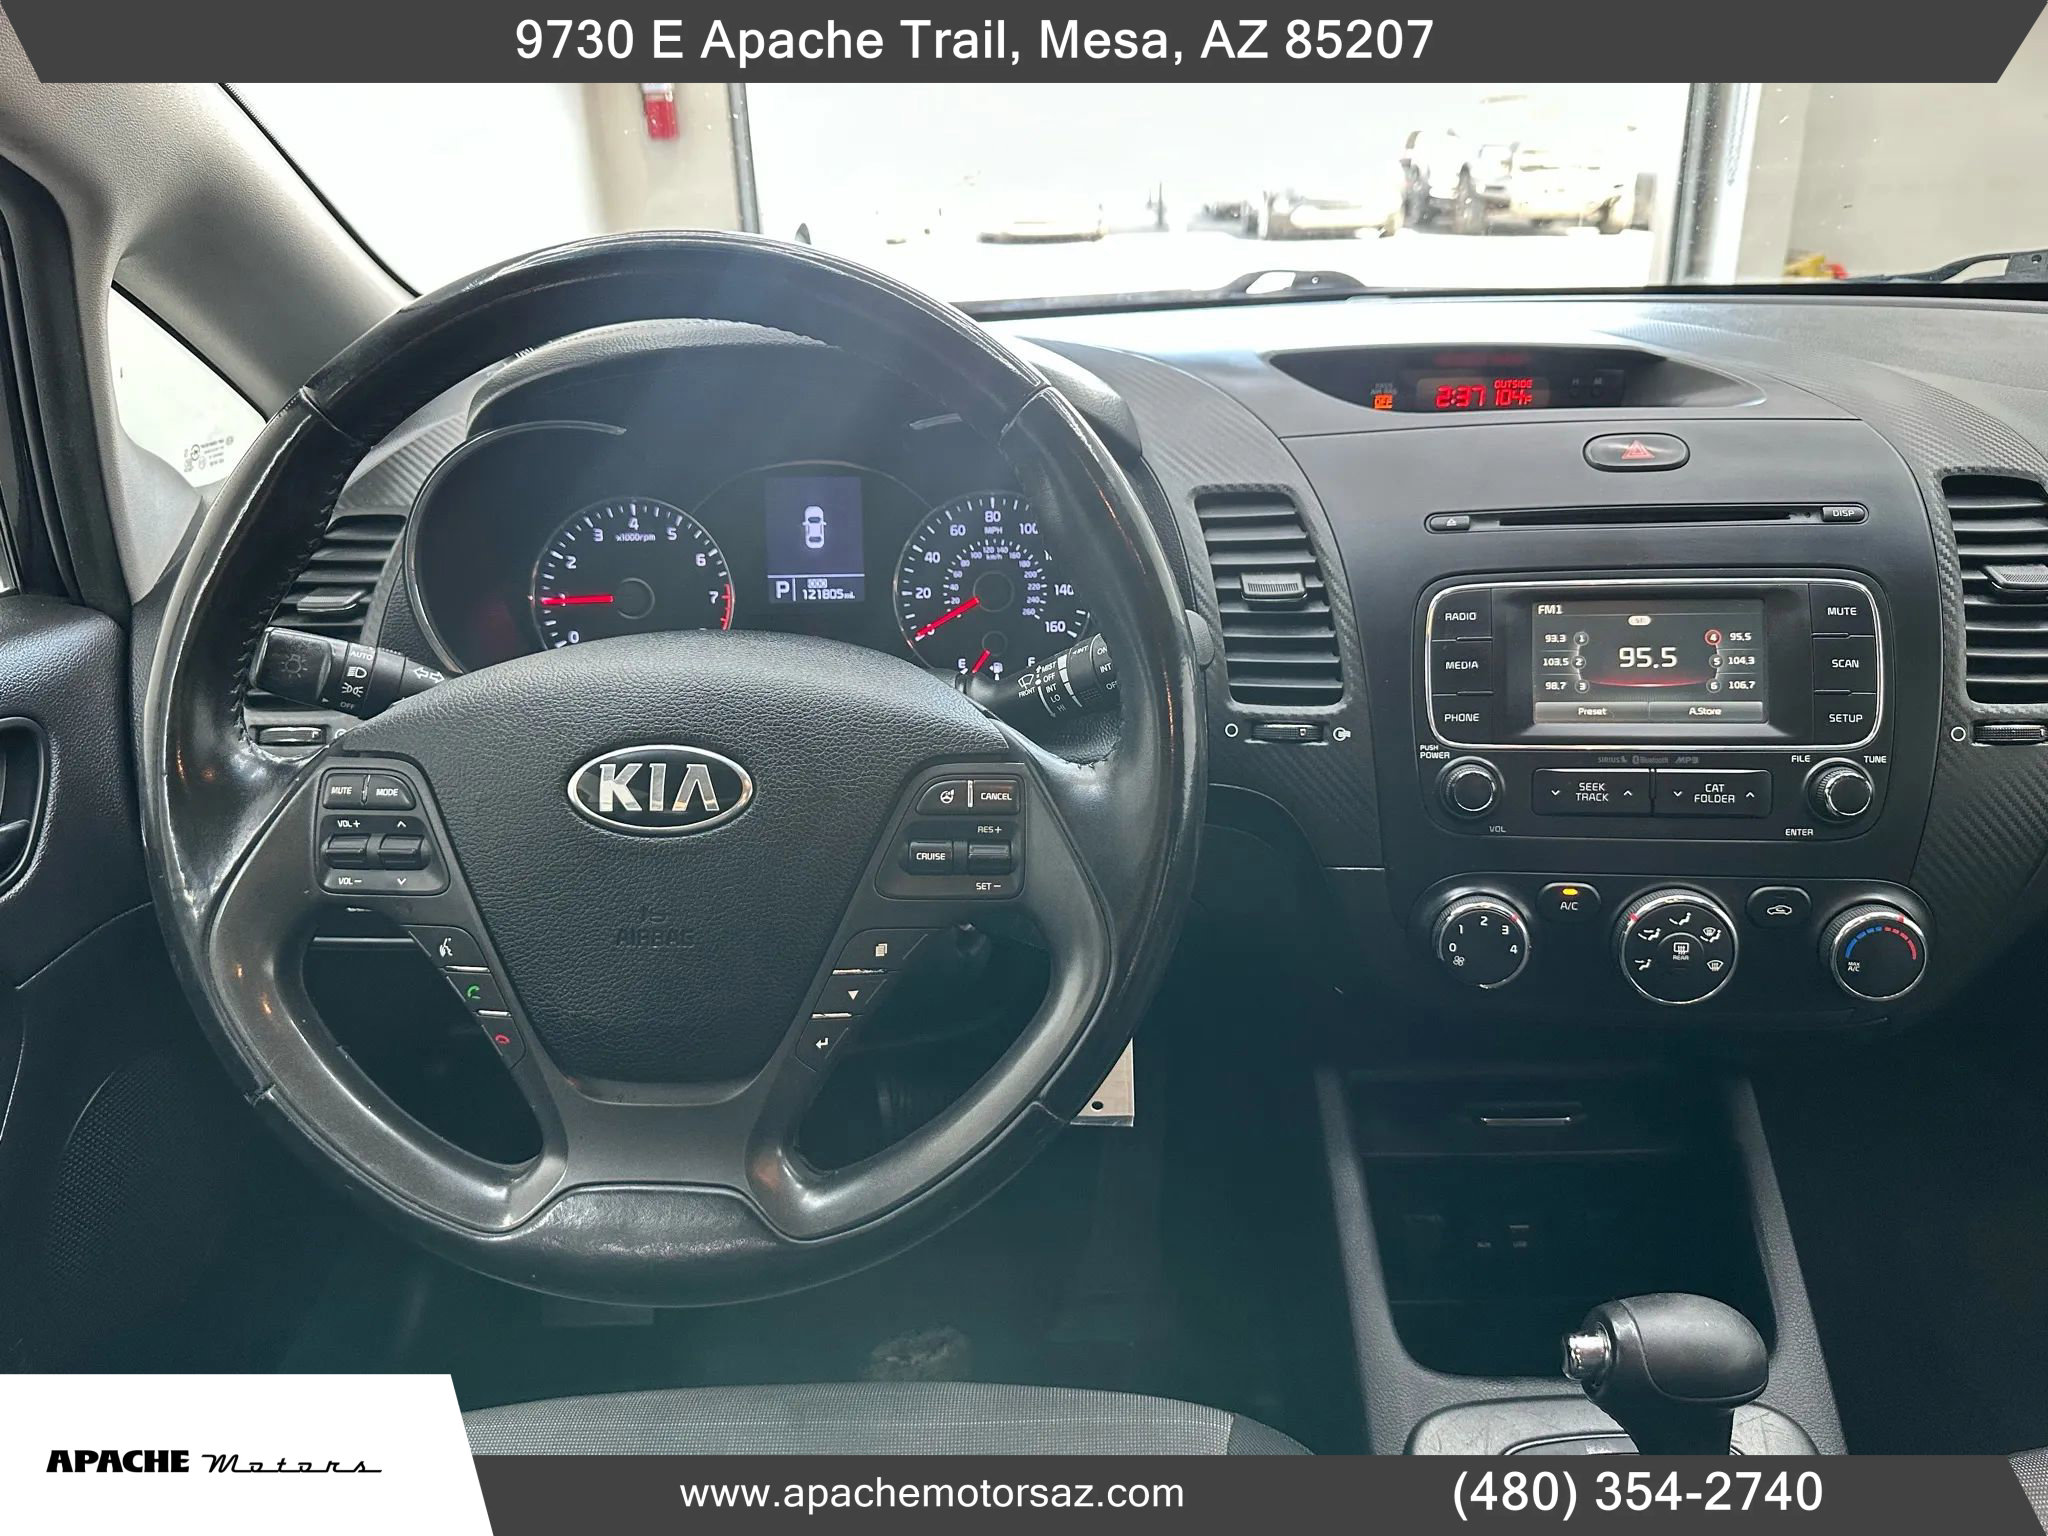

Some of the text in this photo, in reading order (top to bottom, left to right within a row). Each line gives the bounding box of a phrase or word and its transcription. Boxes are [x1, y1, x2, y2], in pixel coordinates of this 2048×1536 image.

[1494, 377, 1533, 389] OUTSIDE
[1435, 385, 1486, 408] 2:37
[984, 510, 1001, 523] 80
[1832, 509, 1855, 517] DISP
[628, 517, 640, 530] 4
[594, 528, 604, 542] 3
[667, 527, 678, 541] 5
[949, 524, 966, 537] 60
[984, 525, 1003, 535] MPH
[566, 555, 577, 570] 2
[695, 553, 706, 567] 6
[924, 552, 941, 564] 40
[1024, 571, 1037, 579] 200
[775, 580, 790, 599] P
[1027, 583, 1041, 591] 220
[709, 591, 719, 604] 7
[915, 587, 931, 599] 20
[1537, 604, 1563, 615] FM1
[1827, 607, 1858, 616] MUTE
[1445, 611, 1477, 621] RADIO
[1045, 621, 1066, 633] 160
[568, 630, 580, 644] 0
[1545, 634, 1566, 643] 93.3
[1709, 632, 1752, 641] 4 95.5
[350, 650, 374, 661] AUTO
[1619, 646, 1678, 669] 95.5
[958, 658, 966, 669] E
[1027, 656, 1036, 667] F
[1445, 660, 1478, 670] MEDIA
[1543, 658, 1583, 667] 103.5 2
[1713, 656, 1755, 666] 5 104.3
[1831, 659, 1860, 668] SCAN
[1041, 660, 1057, 673] MIST
[1100, 662, 1112, 673] INT
[1043, 672, 1056, 683] OFF
[1045, 683, 1057, 694] INT
[1545, 681, 1586, 690] 98.7 3
[1710, 680, 1756, 690] 6 106.7
[1018, 686, 1036, 698] FRONT
[1050, 694, 1061, 703] LO
[340, 701, 354, 710] OFF
[1578, 707, 1607, 716] Preset
[1688, 707, 1722, 716] A.Store
[1444, 713, 1480, 722] PHONE
[1828, 713, 1863, 723] SETUP
[1420, 751, 1450, 759] POWER
[1675, 756, 1699, 764] MP3
[1791, 754, 1811, 763] FILE
[1863, 755, 1887, 763] TUNE
[331, 786, 352, 795] MUTE
[599, 763, 720, 811] KIA
[1579, 782, 1605, 791] SEEK
[1705, 783, 1725, 792] CAT
[376, 788, 399, 797] MODE
[980, 792, 1013, 801] CANCEL
[1575, 792, 1609, 802] TRACK
[1694, 794, 1735, 803] FOLDER
[1488, 825, 1506, 833] VOL
[1785, 828, 1814, 836] ENTER
[916, 852, 946, 861] CRUISE
[1560, 901, 1579, 911] A/C
[1480, 916, 1488, 926] 2
[1458, 924, 1464, 935] 1
[1501, 925, 1510, 935] 3
[1448, 942, 1457, 953] 0
[1509, 944, 1518, 954] 4
